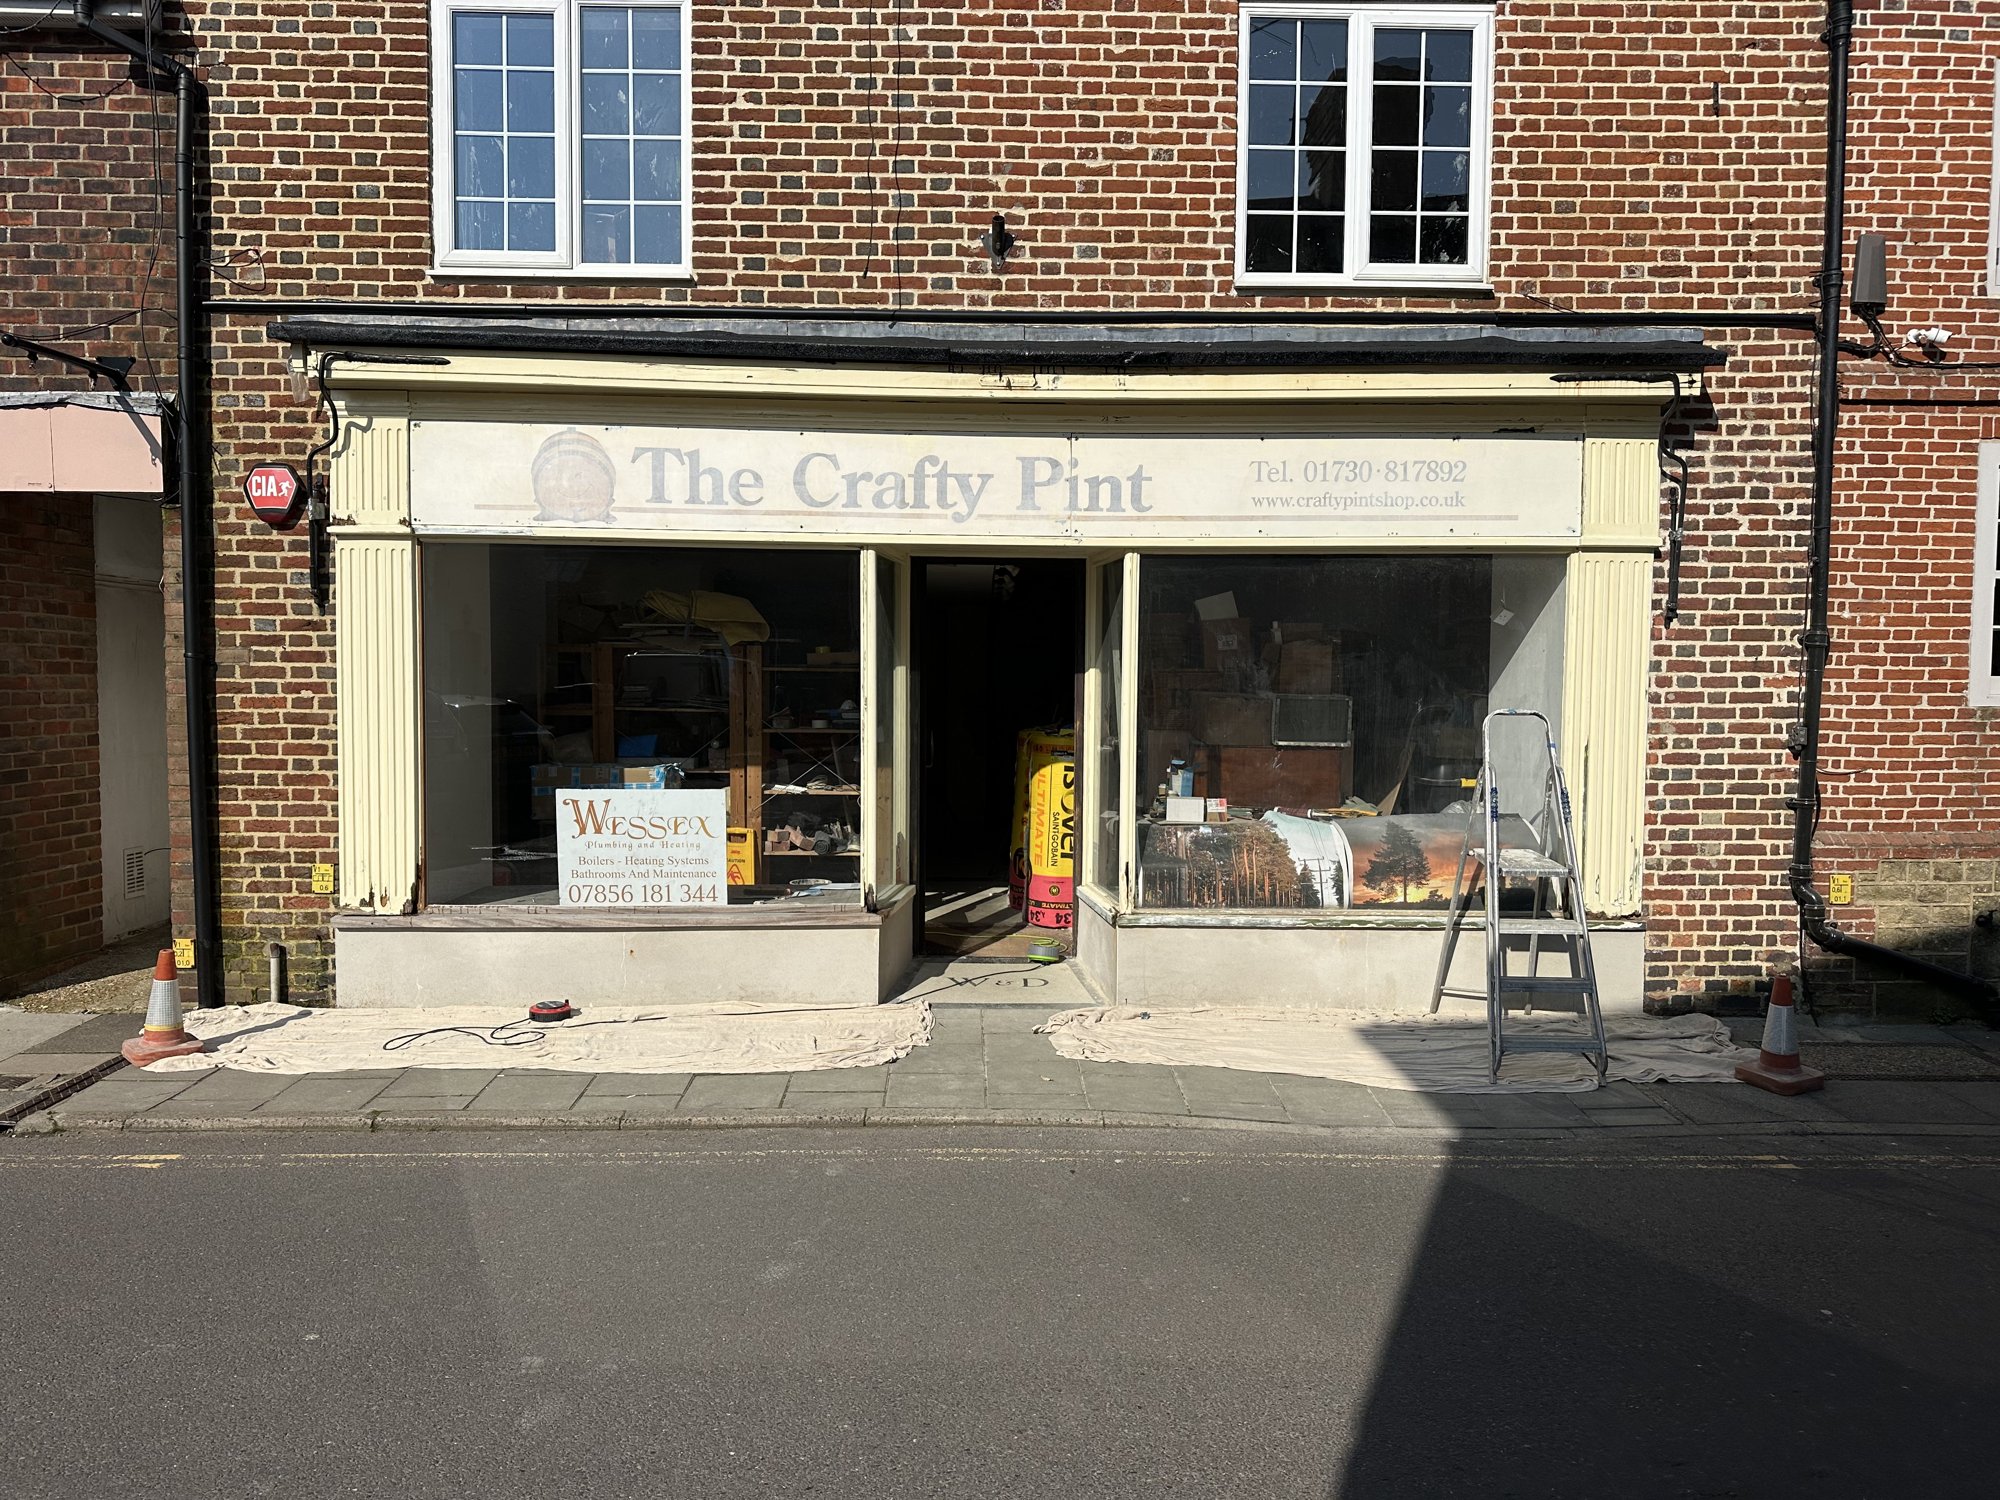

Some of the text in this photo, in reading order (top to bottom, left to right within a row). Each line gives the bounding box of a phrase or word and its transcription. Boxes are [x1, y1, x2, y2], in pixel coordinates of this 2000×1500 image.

[1249, 460, 1294, 482] Tel.
[251, 475, 278, 497] CIA
[630, 446, 1153, 523] The Crafty Pint
[1251, 491, 1466, 511] www.craftypintshop.co.uk
[562, 798, 721, 840] WESSEX
[1034, 764, 1047, 868] ULTIMATE
[585, 841, 701, 851] Plumbing and Heating
[578, 856, 615, 866] Boilers
[625, 856, 665, 868] Heating
[667, 856, 709, 867] Systems
[571, 869, 717, 879] Bathrooms And Maintenance
[568, 883, 719, 903] 07856 181 344
[947, 977, 990, 987] W
[1022, 977, 1049, 988] D
